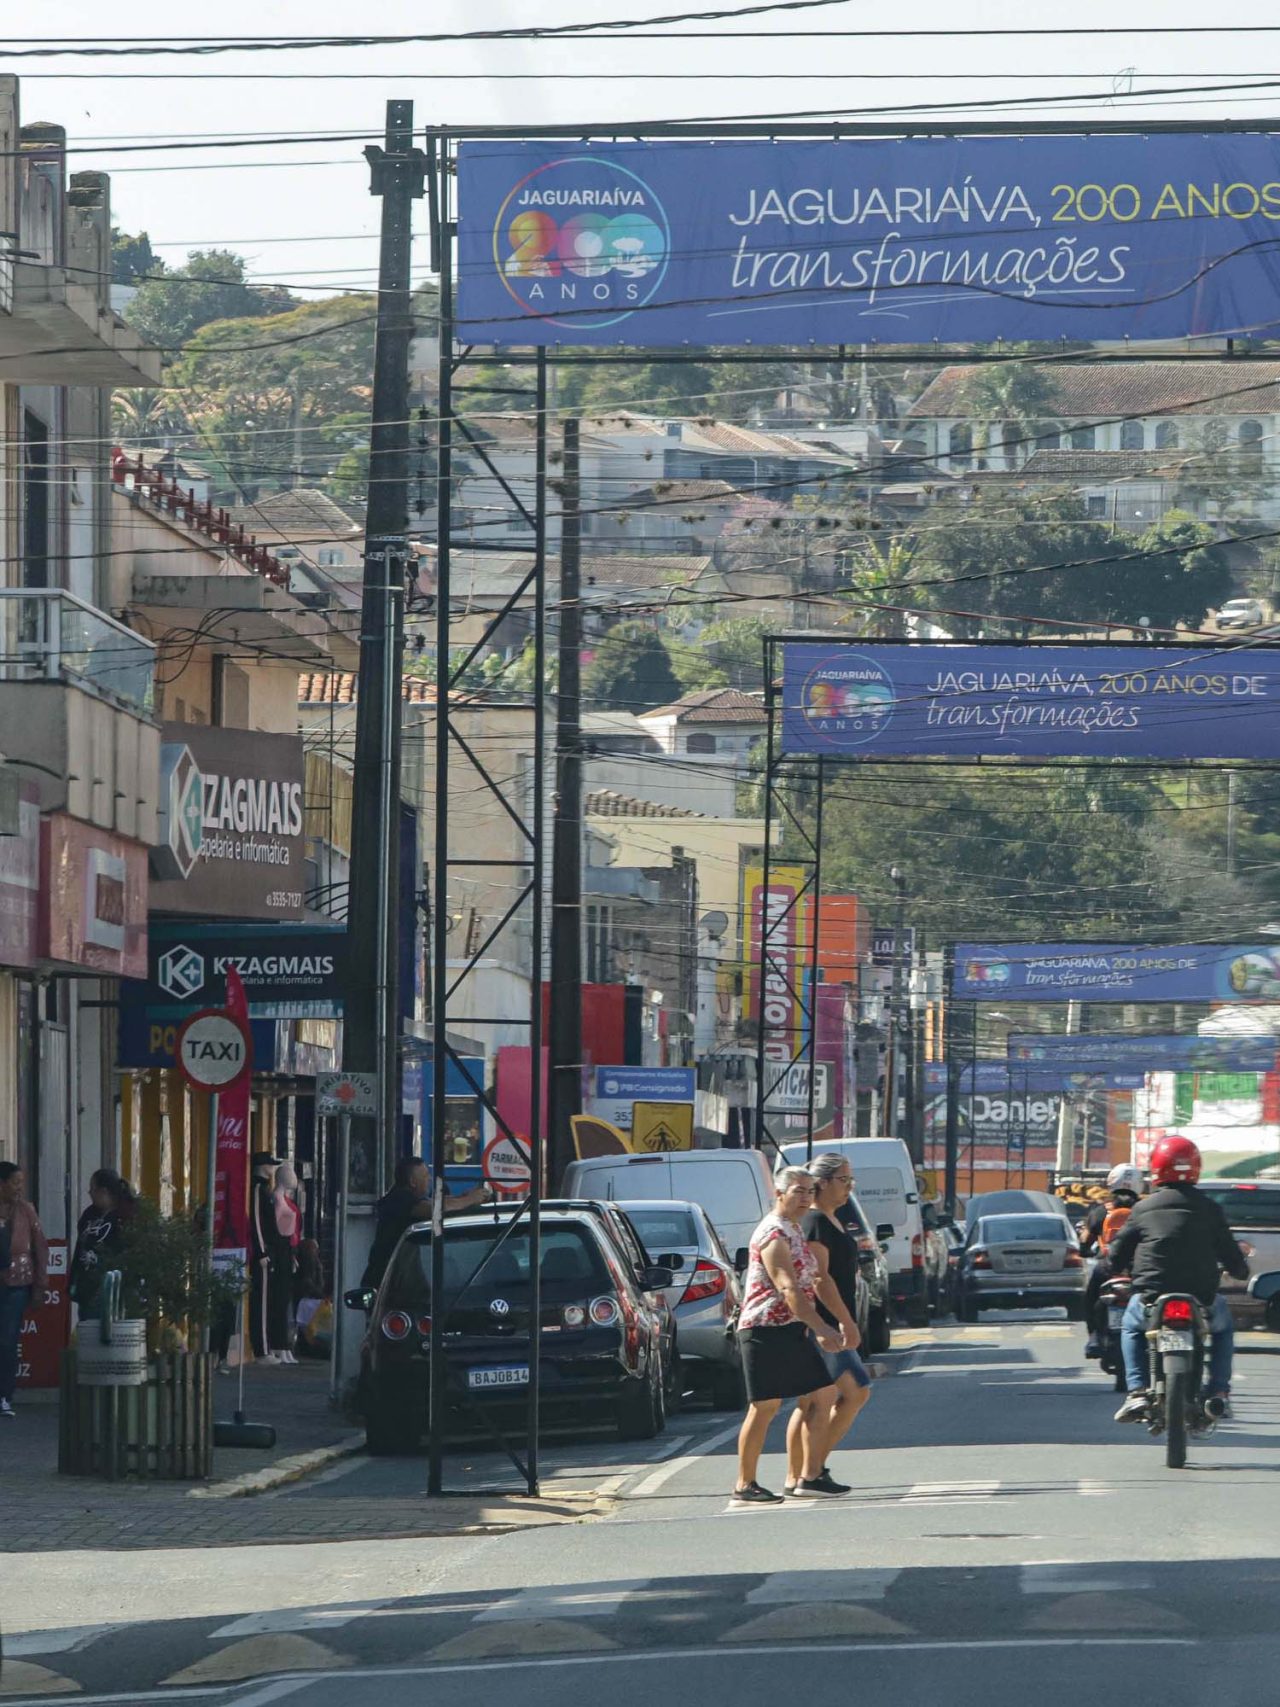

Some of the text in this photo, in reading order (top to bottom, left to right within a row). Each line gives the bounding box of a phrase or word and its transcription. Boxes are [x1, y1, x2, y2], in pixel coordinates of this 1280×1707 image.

[518, 188, 645, 205] JAGUARIAÍVA
[729, 176, 1041, 227] JAGUARIAÍVA,
[1051, 184, 1141, 222] 200
[731, 232, 1130, 304] transformações
[529, 283, 639, 299] ANOS
[1098, 673, 1147, 694] 200
[1152, 674, 1228, 695] ANOS
[1232, 676, 1268, 695] DE
[820, 720, 879, 730] ANOS
[926, 696, 1141, 735] transformações
[200, 773, 302, 837] IZAGMAIS
[200, 833, 290, 865] apelaria e informática
[151, 1025, 177, 1054] PO
[187, 1039, 240, 1062] TAXI
[319, 1074, 371, 1096] PRIVATIVO
